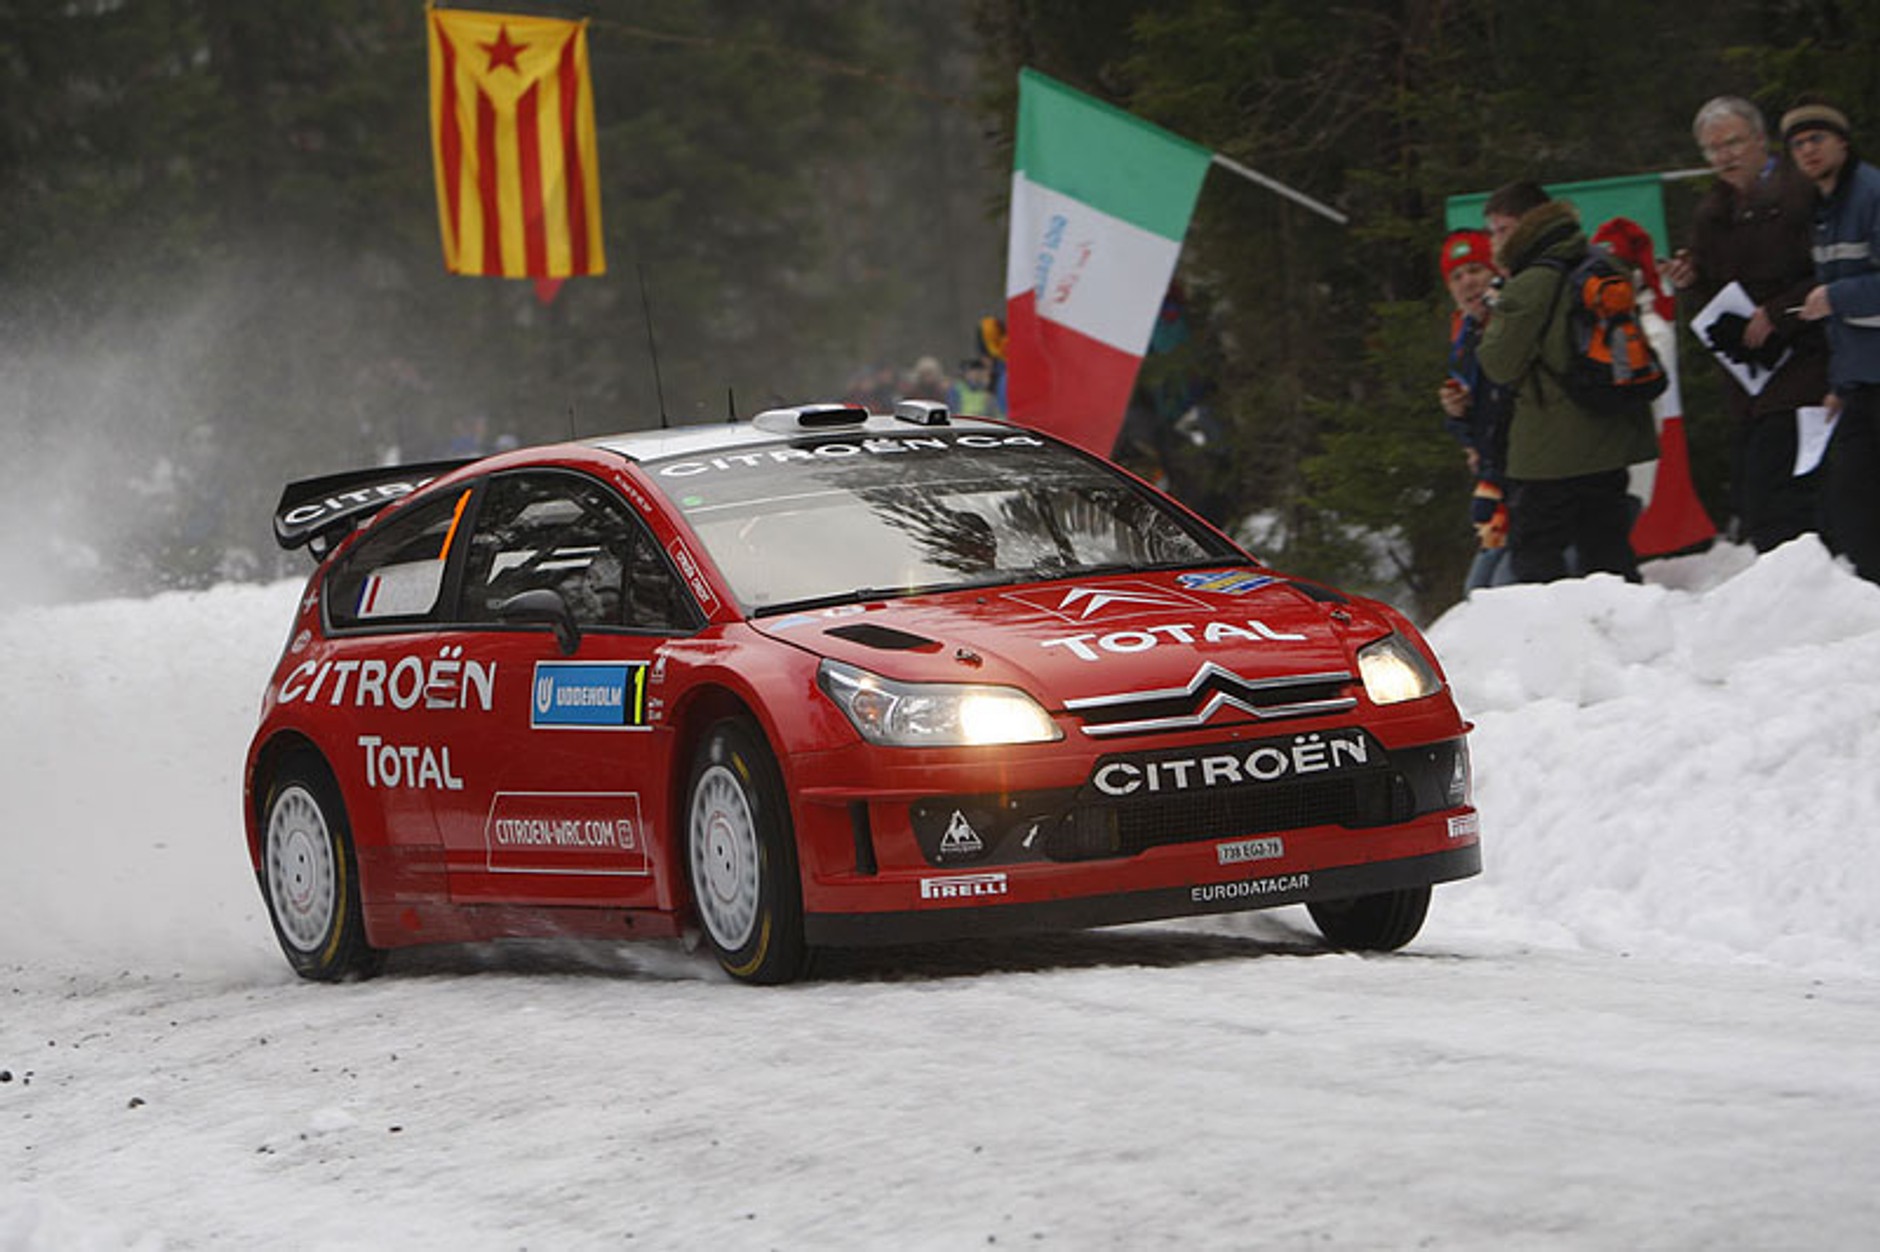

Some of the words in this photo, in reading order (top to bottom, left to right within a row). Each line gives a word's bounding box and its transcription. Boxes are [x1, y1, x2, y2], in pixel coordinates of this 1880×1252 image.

[955, 435, 1044, 449] C4
[284, 476, 438, 525] CITR
[1041, 620, 1308, 662] TOTAL
[277, 645, 497, 712] CITROËN
[634, 663, 646, 725] 1
[358, 735, 465, 790] TOTAL
[1093, 734, 1368, 797] CITROËN
[921, 872, 1008, 899] PIRELLI
[1190, 873, 1310, 902] EURODATACAR
